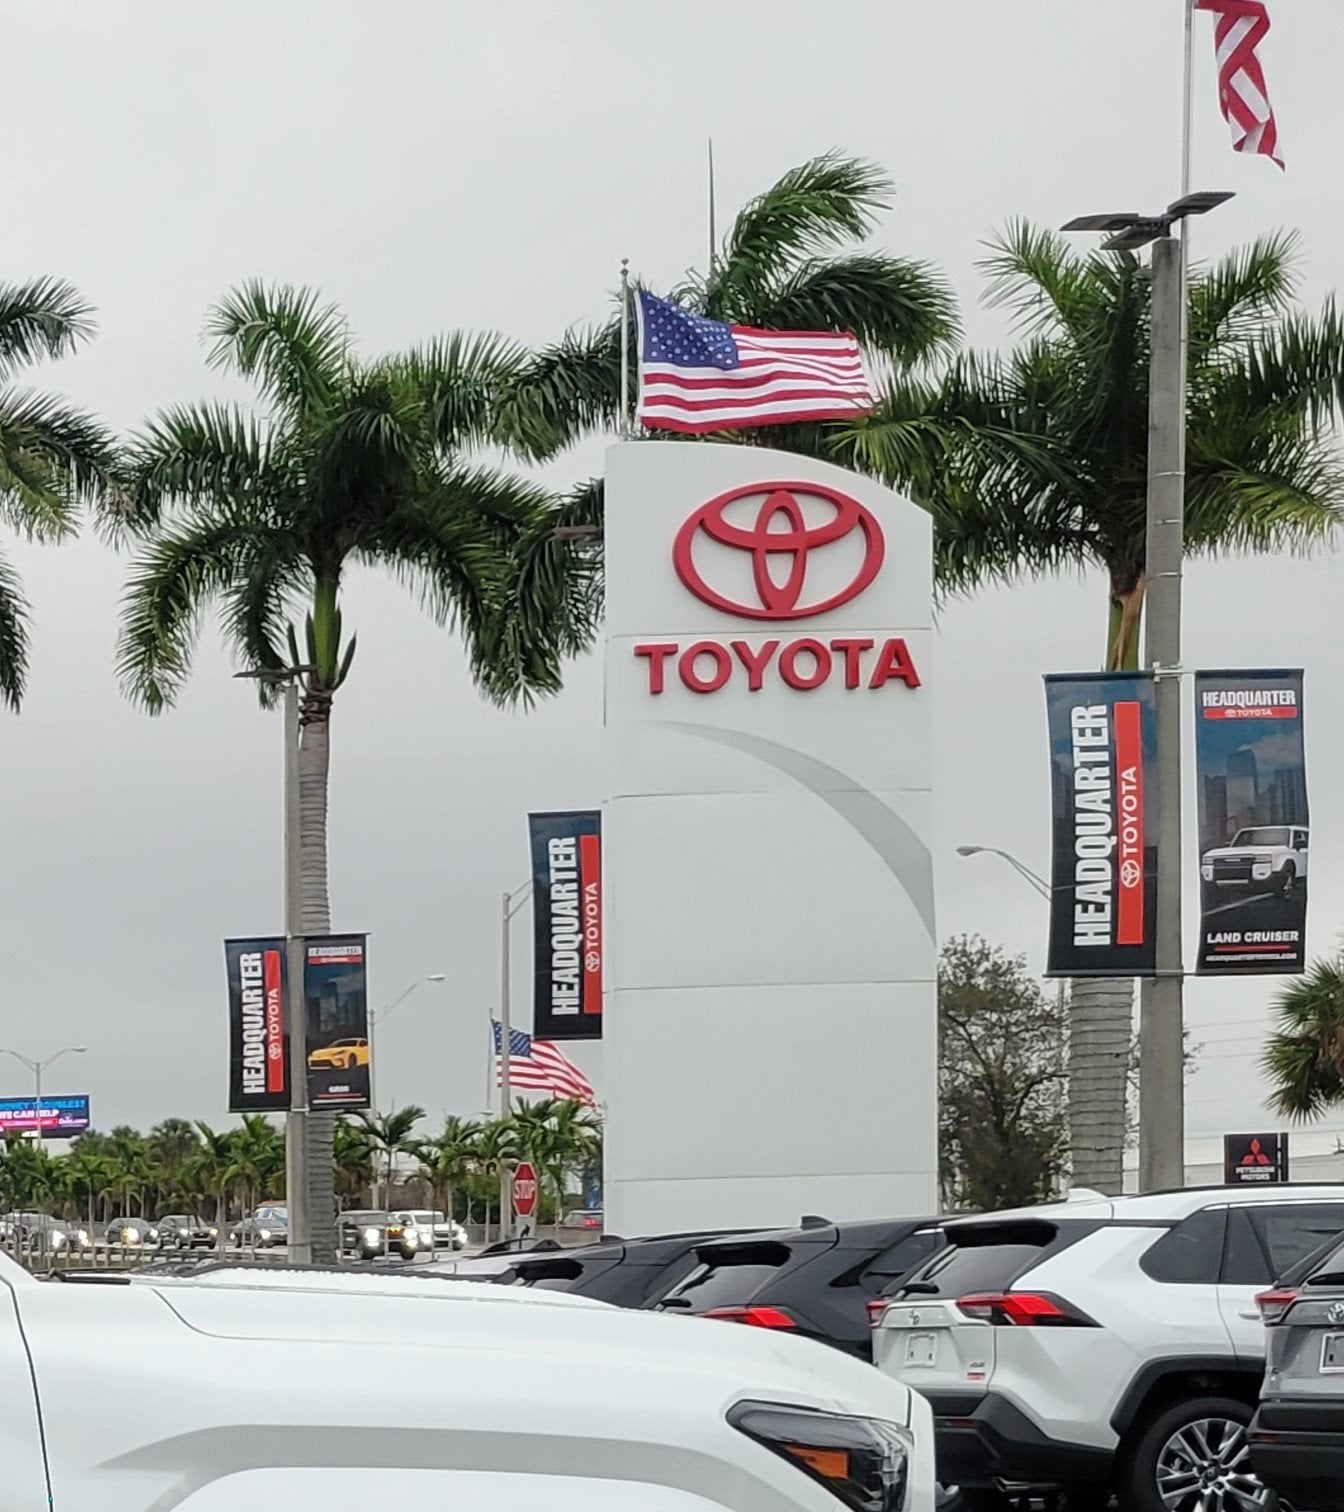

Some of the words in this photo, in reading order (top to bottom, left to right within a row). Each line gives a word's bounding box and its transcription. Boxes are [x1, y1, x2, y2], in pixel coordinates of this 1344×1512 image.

[634, 638, 921, 694] TOYOTA
[1202, 690, 1296, 708] HEADQUARTER
[1070, 704, 1118, 946] HEADQUARTER
[1121, 766, 1139, 857] TOYOTA
[548, 837, 583, 1016] HEADQUARTER
[585, 882, 599, 949] TOYOTA
[1206, 932, 1242, 944] LAND
[1244, 930, 1300, 942] CRUISER
[240, 952, 268, 1094] HEADQUARTER
[267, 988, 280, 1042] TOYOTA
[514, 1180, 535, 1199] STOP
